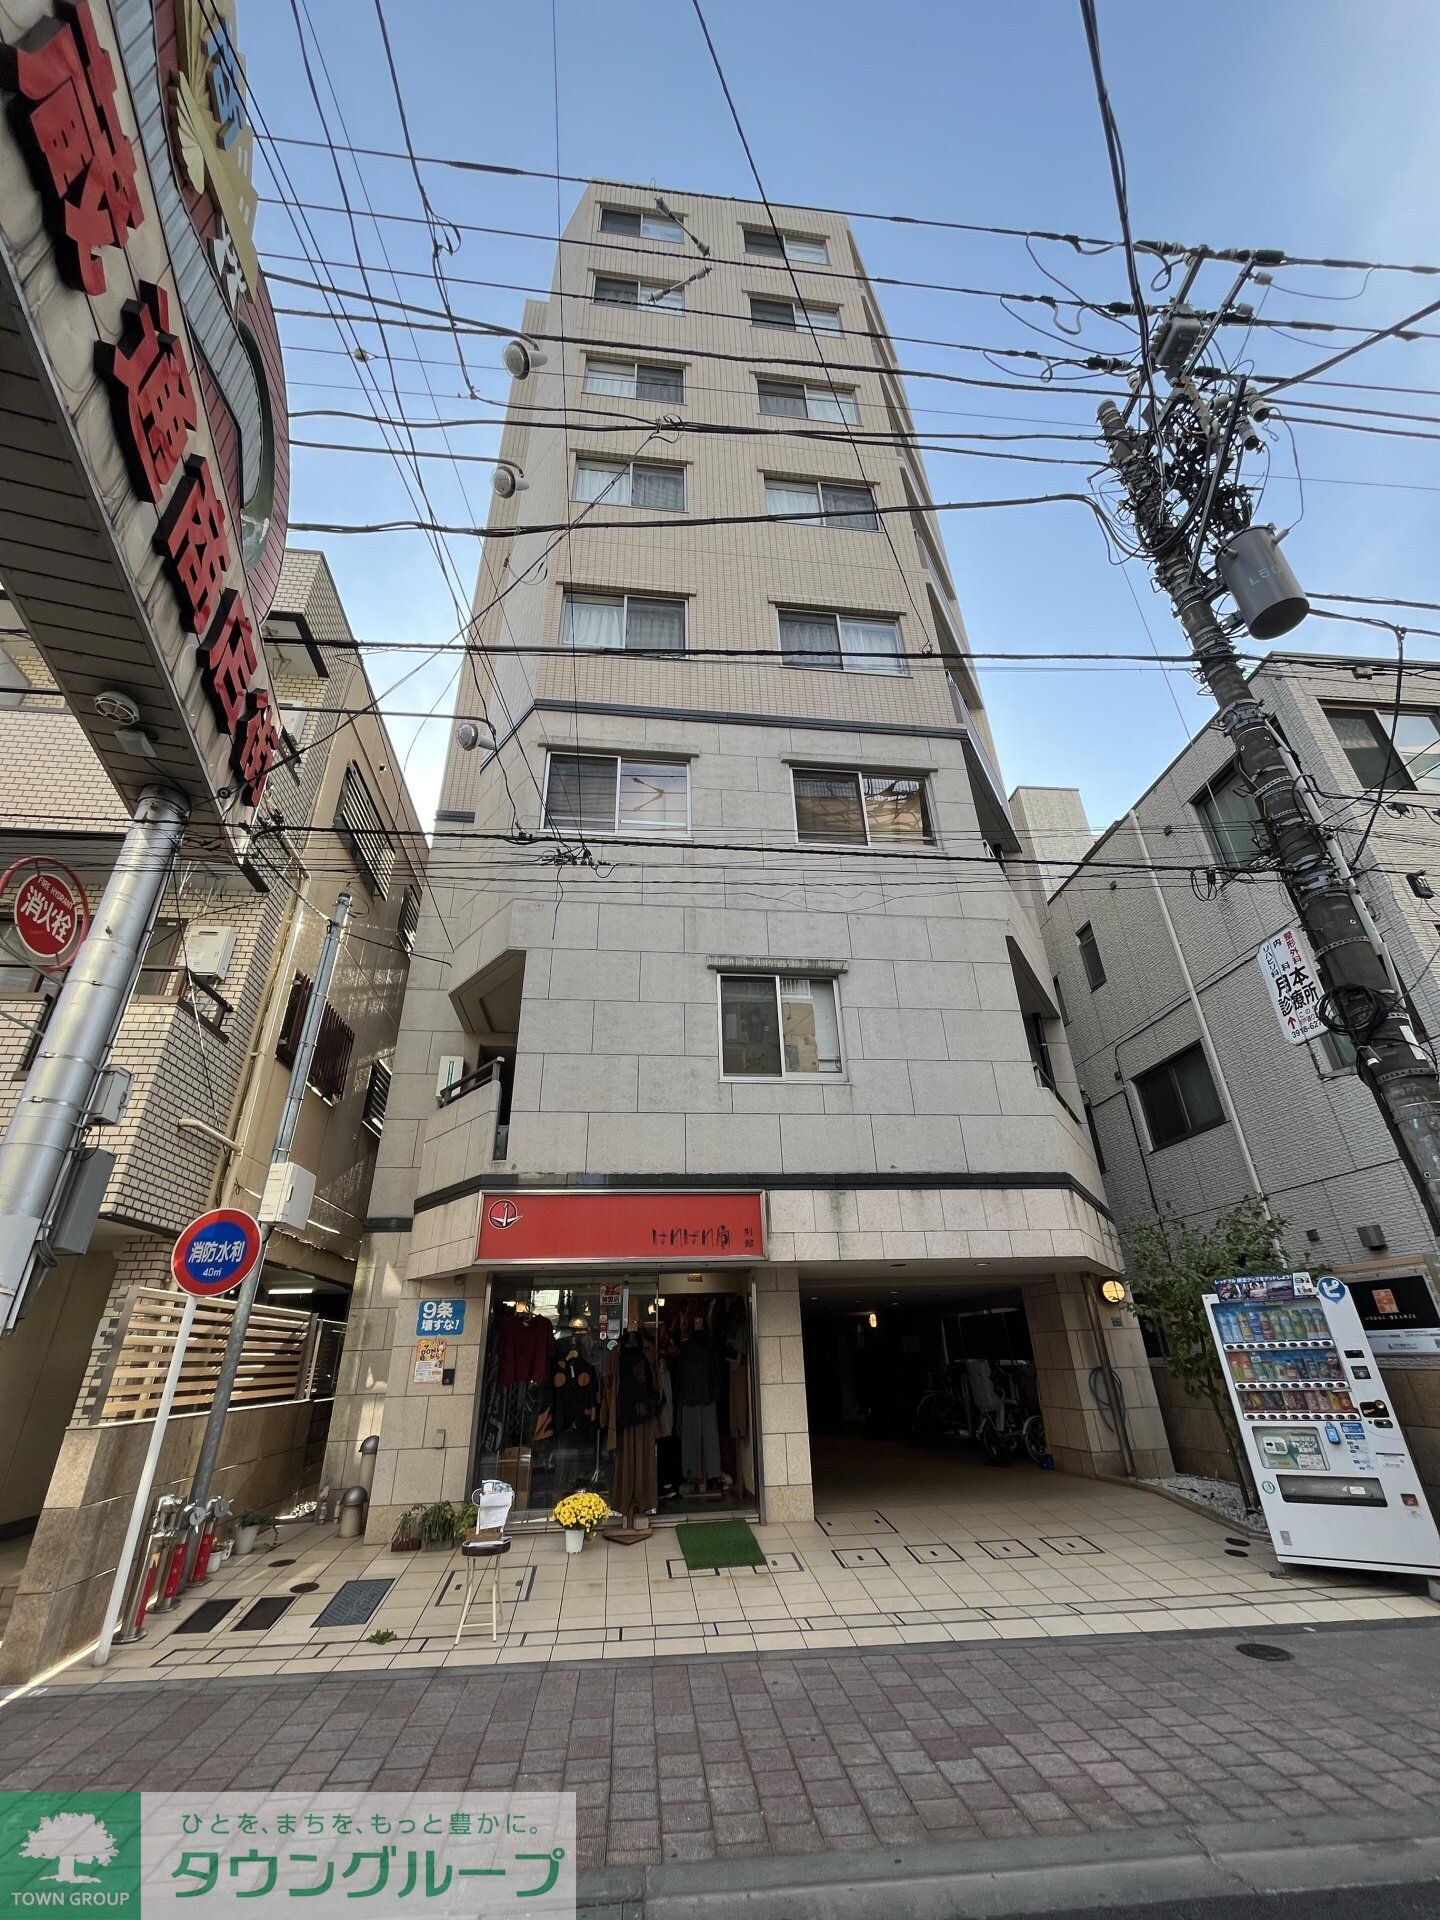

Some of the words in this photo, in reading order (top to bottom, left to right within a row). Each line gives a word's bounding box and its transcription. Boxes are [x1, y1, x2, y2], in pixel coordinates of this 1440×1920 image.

[37, 876, 52, 892] FIRE
[51, 887, 74, 910] HYDRANT
[20, 885, 72, 944] 消火栓
[1262, 945, 1280, 978] リハビリ科
[1283, 930, 1302, 965] 整形外科
[1278, 981, 1320, 1017] 診療所
[188, 1240, 246, 1264] 消防水利
[420, 1319, 460, 1332] 壊すな!
[422, 1301, 454, 1319] 9条
